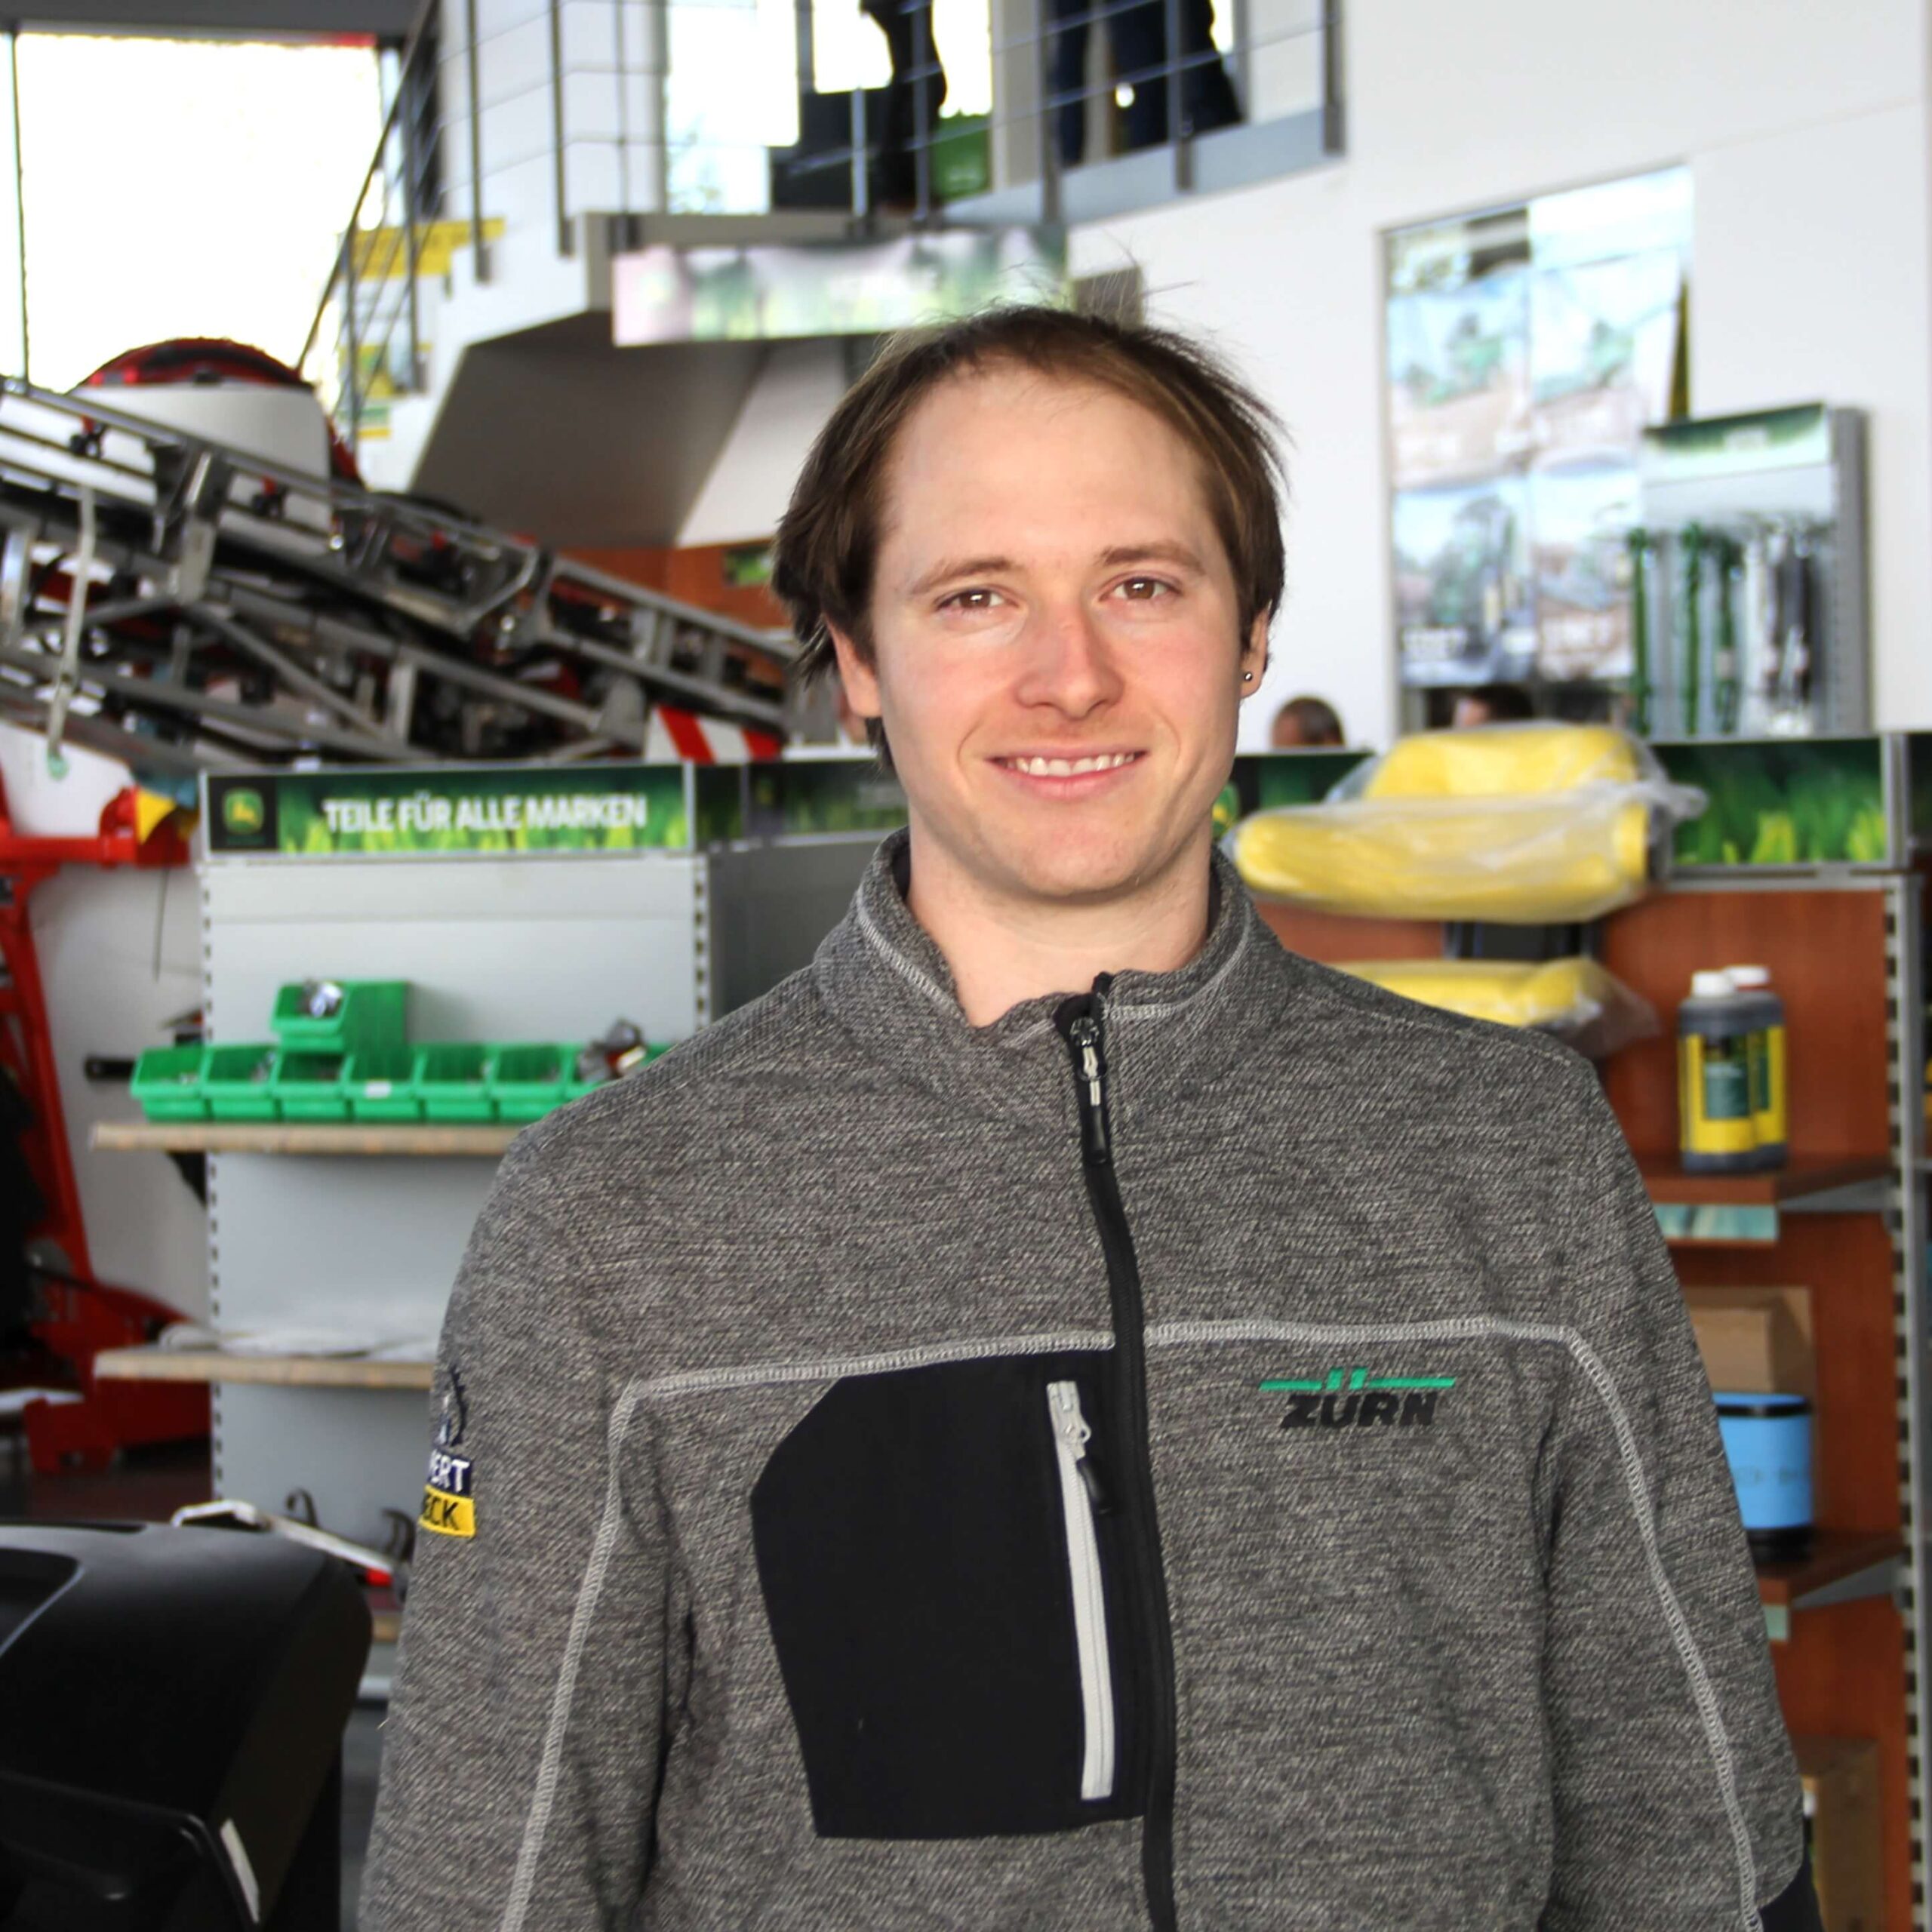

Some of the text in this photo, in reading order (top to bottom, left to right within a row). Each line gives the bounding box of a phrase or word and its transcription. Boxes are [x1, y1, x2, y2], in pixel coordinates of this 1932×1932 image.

[322, 790, 648, 832] TEILE FÜR ALLE MARKEN
[1281, 1367, 1438, 1429] ZÜRN
